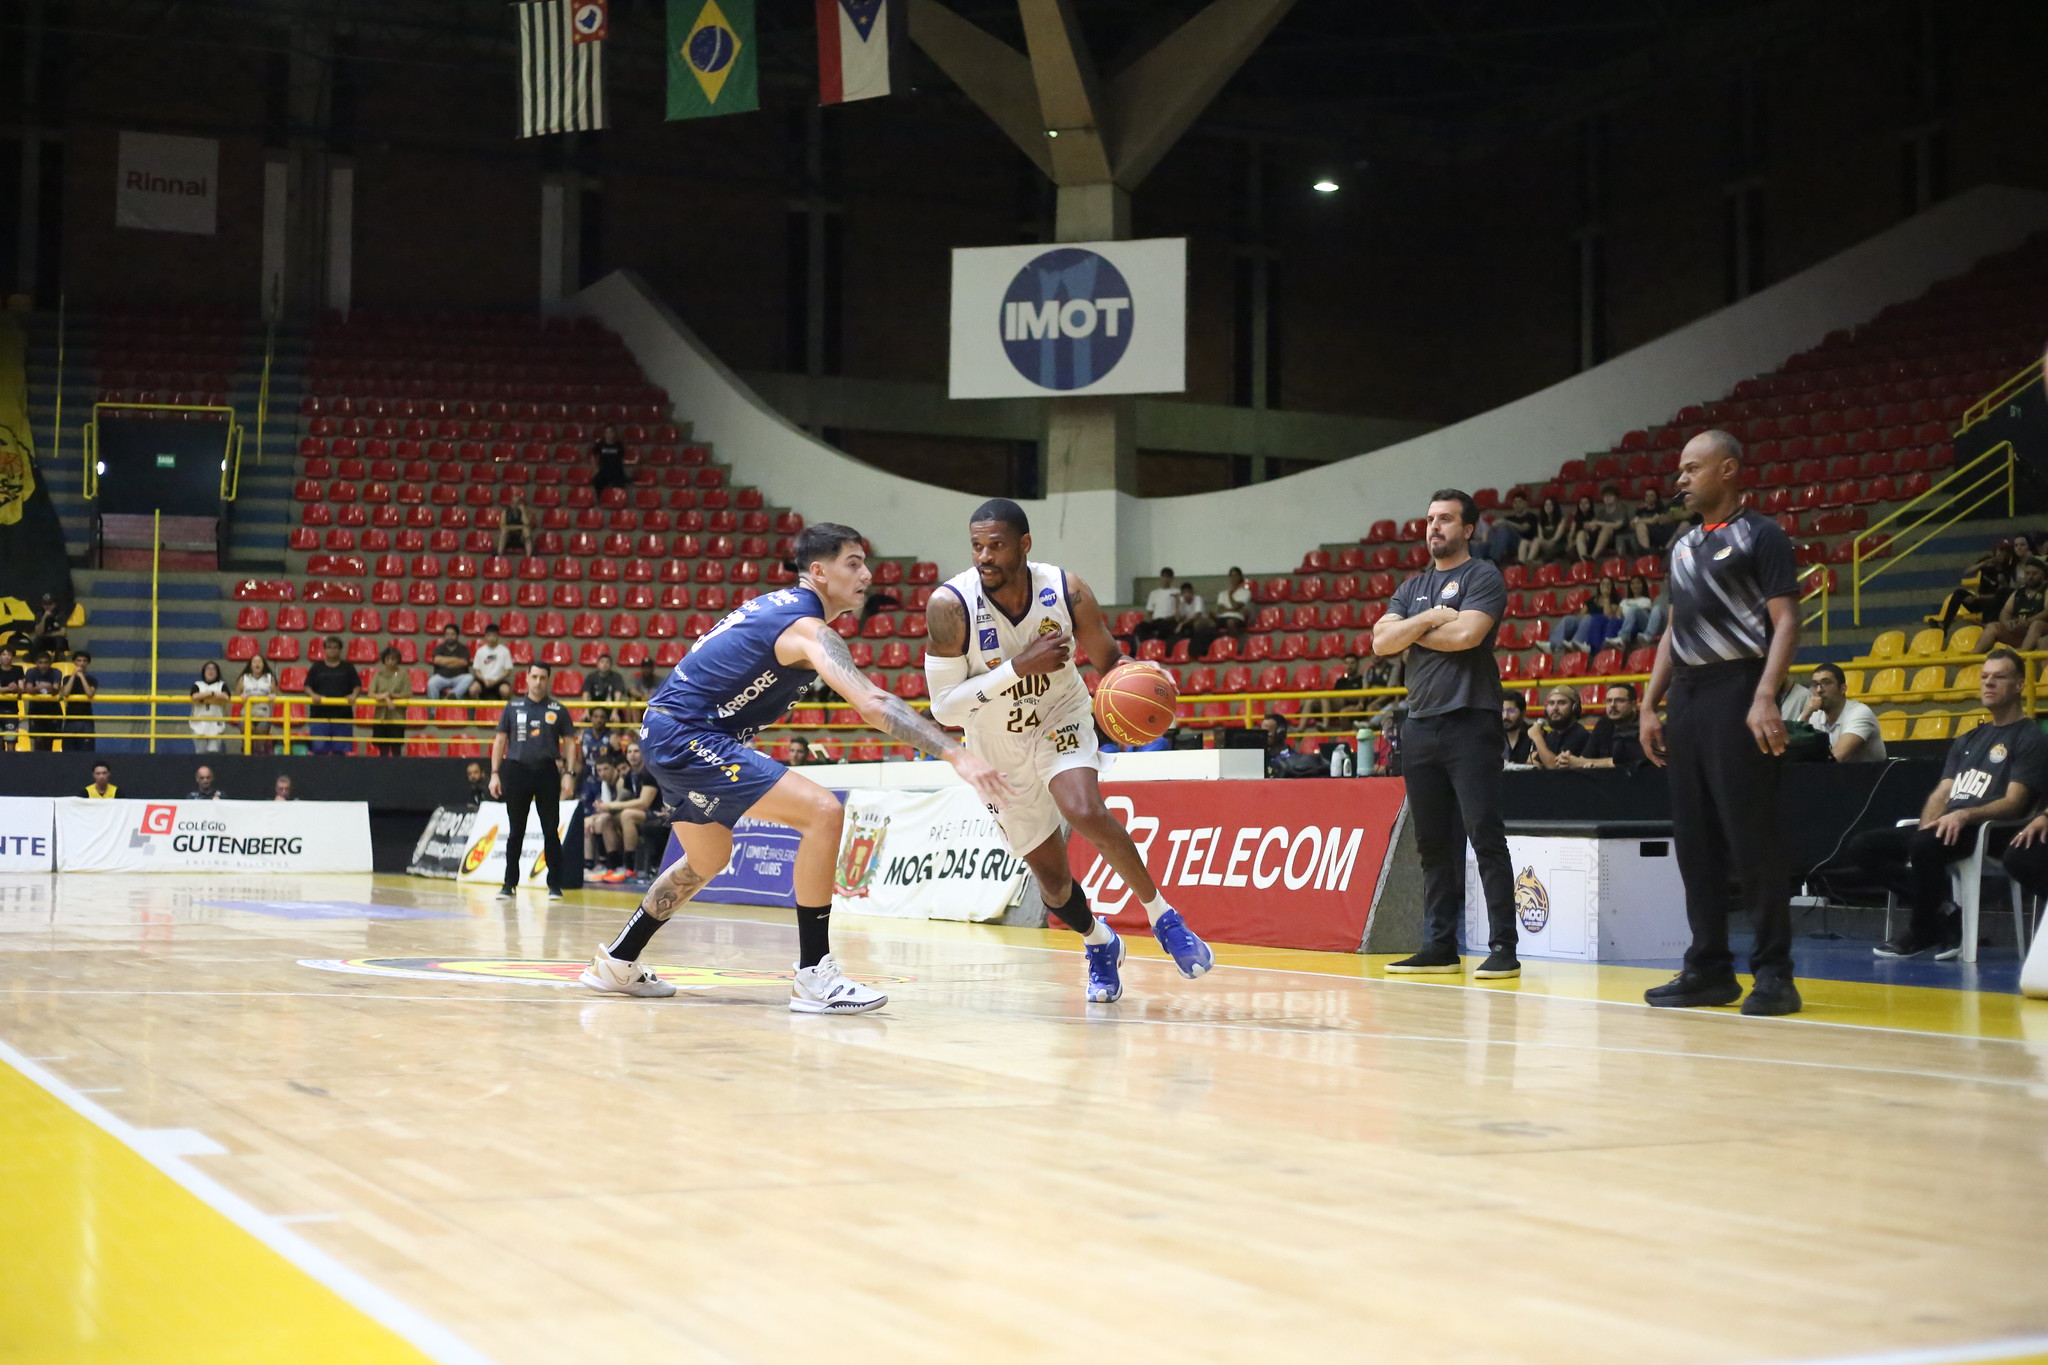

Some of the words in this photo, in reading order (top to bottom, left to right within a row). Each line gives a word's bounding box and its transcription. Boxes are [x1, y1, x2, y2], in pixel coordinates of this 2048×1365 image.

[126, 170, 206, 197] Rinnai
[1004, 297, 1129, 341] IMOT
[716, 669, 778, 718] ÁRBORE
[1007, 707, 1041, 733] 24
[1056, 722, 1079, 734] MRV
[1055, 733, 1080, 753] 24
[178, 820, 226, 831] COLÉGIO
[0, 836, 45, 856] TE
[172, 834, 303, 855] GUTENBERG
[759, 862, 782, 876] CLUBES
[884, 851, 938, 886] MOG
[938, 848, 980, 879] DAS
[1162, 825, 1364, 892] TELECOM
[1522, 908, 1545, 921] MOGI
